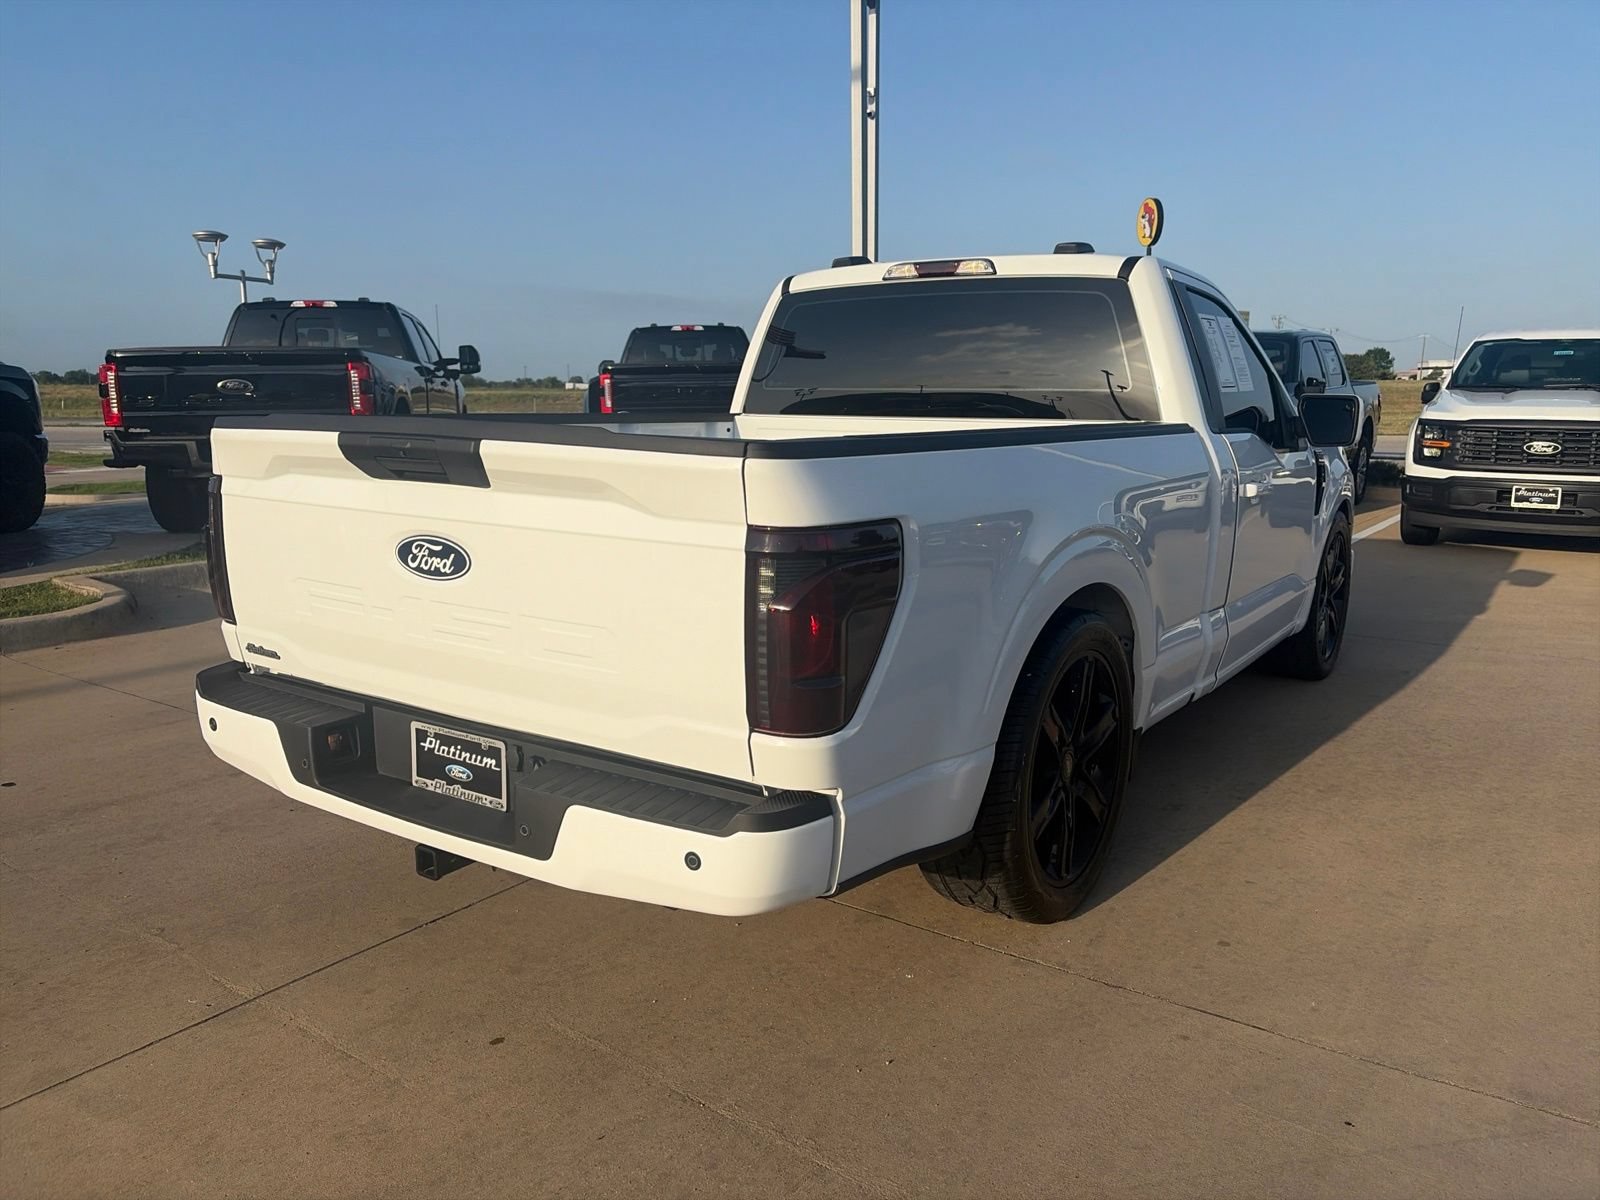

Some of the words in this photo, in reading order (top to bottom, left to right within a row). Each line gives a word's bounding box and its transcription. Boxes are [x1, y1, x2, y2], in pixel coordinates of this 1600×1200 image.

[1530, 441, 1555, 453] Ford
[1516, 489, 1558, 498] Platinum
[407, 541, 455, 574] Ford
[420, 736, 501, 771] Platinum
[450, 767, 468, 780] Ford
[433, 779, 488, 806] Platinum
